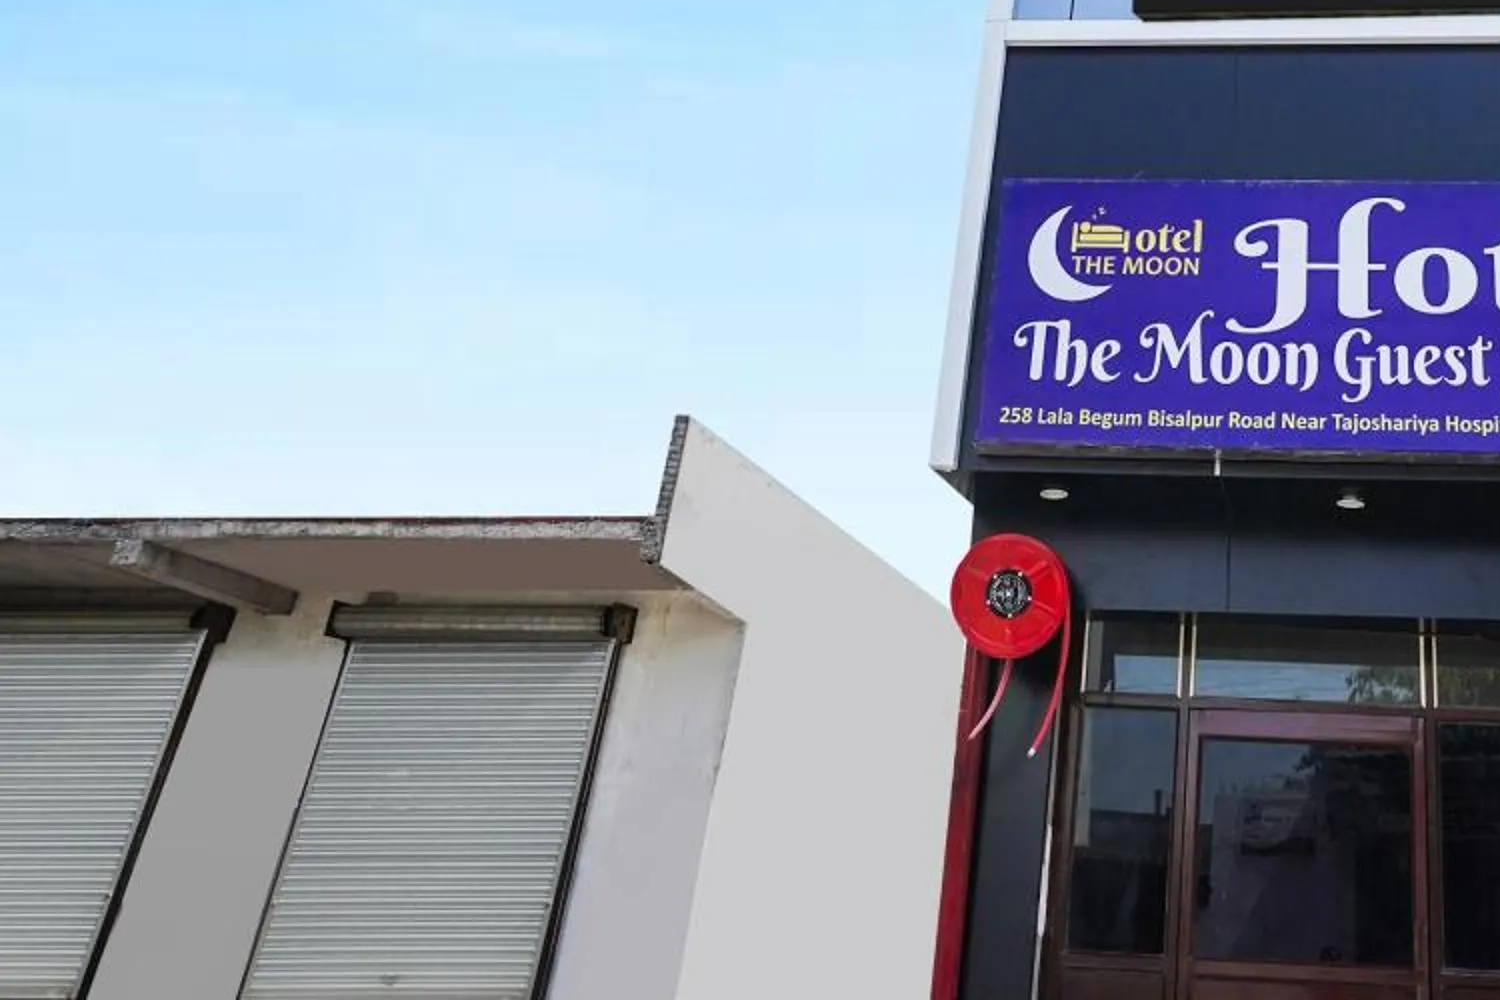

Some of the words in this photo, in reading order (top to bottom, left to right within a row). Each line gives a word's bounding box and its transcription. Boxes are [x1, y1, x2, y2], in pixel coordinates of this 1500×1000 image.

[1071, 255, 1116, 275] THE
[1121, 256, 1200, 276] MOON
[1013, 318, 1121, 388] The
[1133, 309, 1319, 392] Moon
[1333, 327, 1493, 403] Guest
[999, 406, 1033, 425] 258
[1037, 407, 1074, 425] Lala
[1078, 408, 1143, 430] Begum
[1147, 409, 1224, 431] Bisalpur
[1228, 411, 1276, 430] Road
[1281, 412, 1328, 430] Near
[1331, 413, 1440, 436] Tajoshariya
